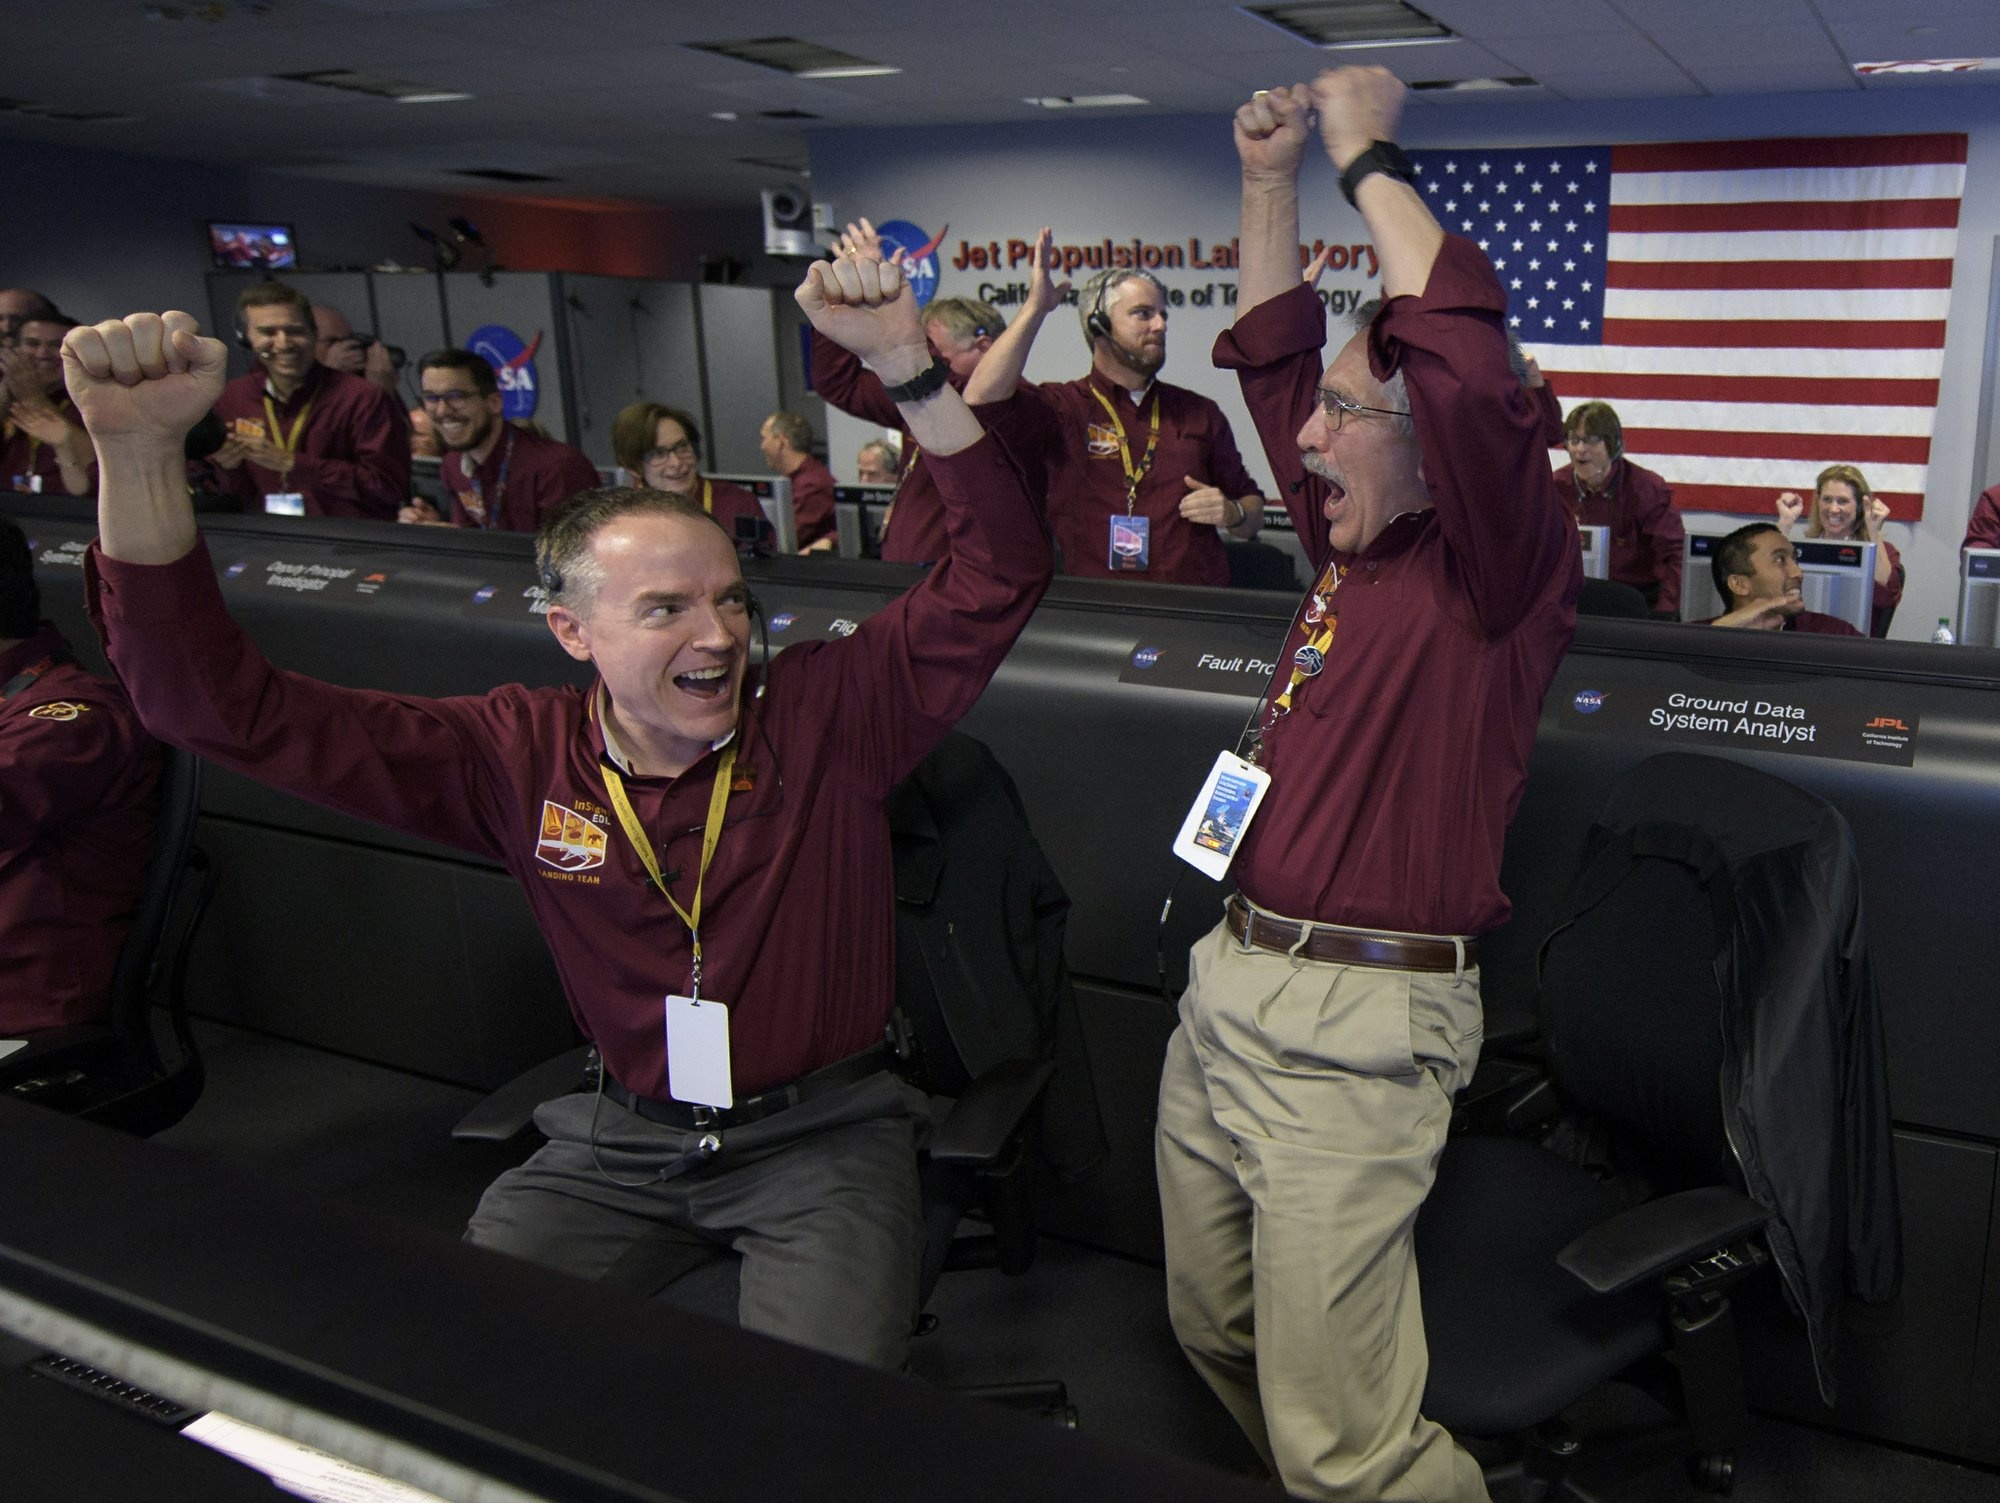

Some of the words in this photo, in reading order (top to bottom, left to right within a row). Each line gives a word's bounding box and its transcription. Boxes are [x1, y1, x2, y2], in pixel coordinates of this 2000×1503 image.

[903, 257, 936, 279] SA
[953, 239, 1001, 269] Jet
[1007, 239, 1183, 276] Propulsion
[1191, 283, 1213, 306] of
[496, 366, 536, 392] SA
[1197, 654, 1243, 672] Fault
[1575, 696, 1602, 706] NASA
[1667, 692, 1749, 714] Ground
[1753, 701, 1806, 720] Data
[1649, 708, 1729, 732] System
[1733, 716, 1817, 744] Analyst
[1865, 717, 1909, 730] JPL
[592, 813, 611, 826] EDL
[576, 874, 600, 885] TEAM
